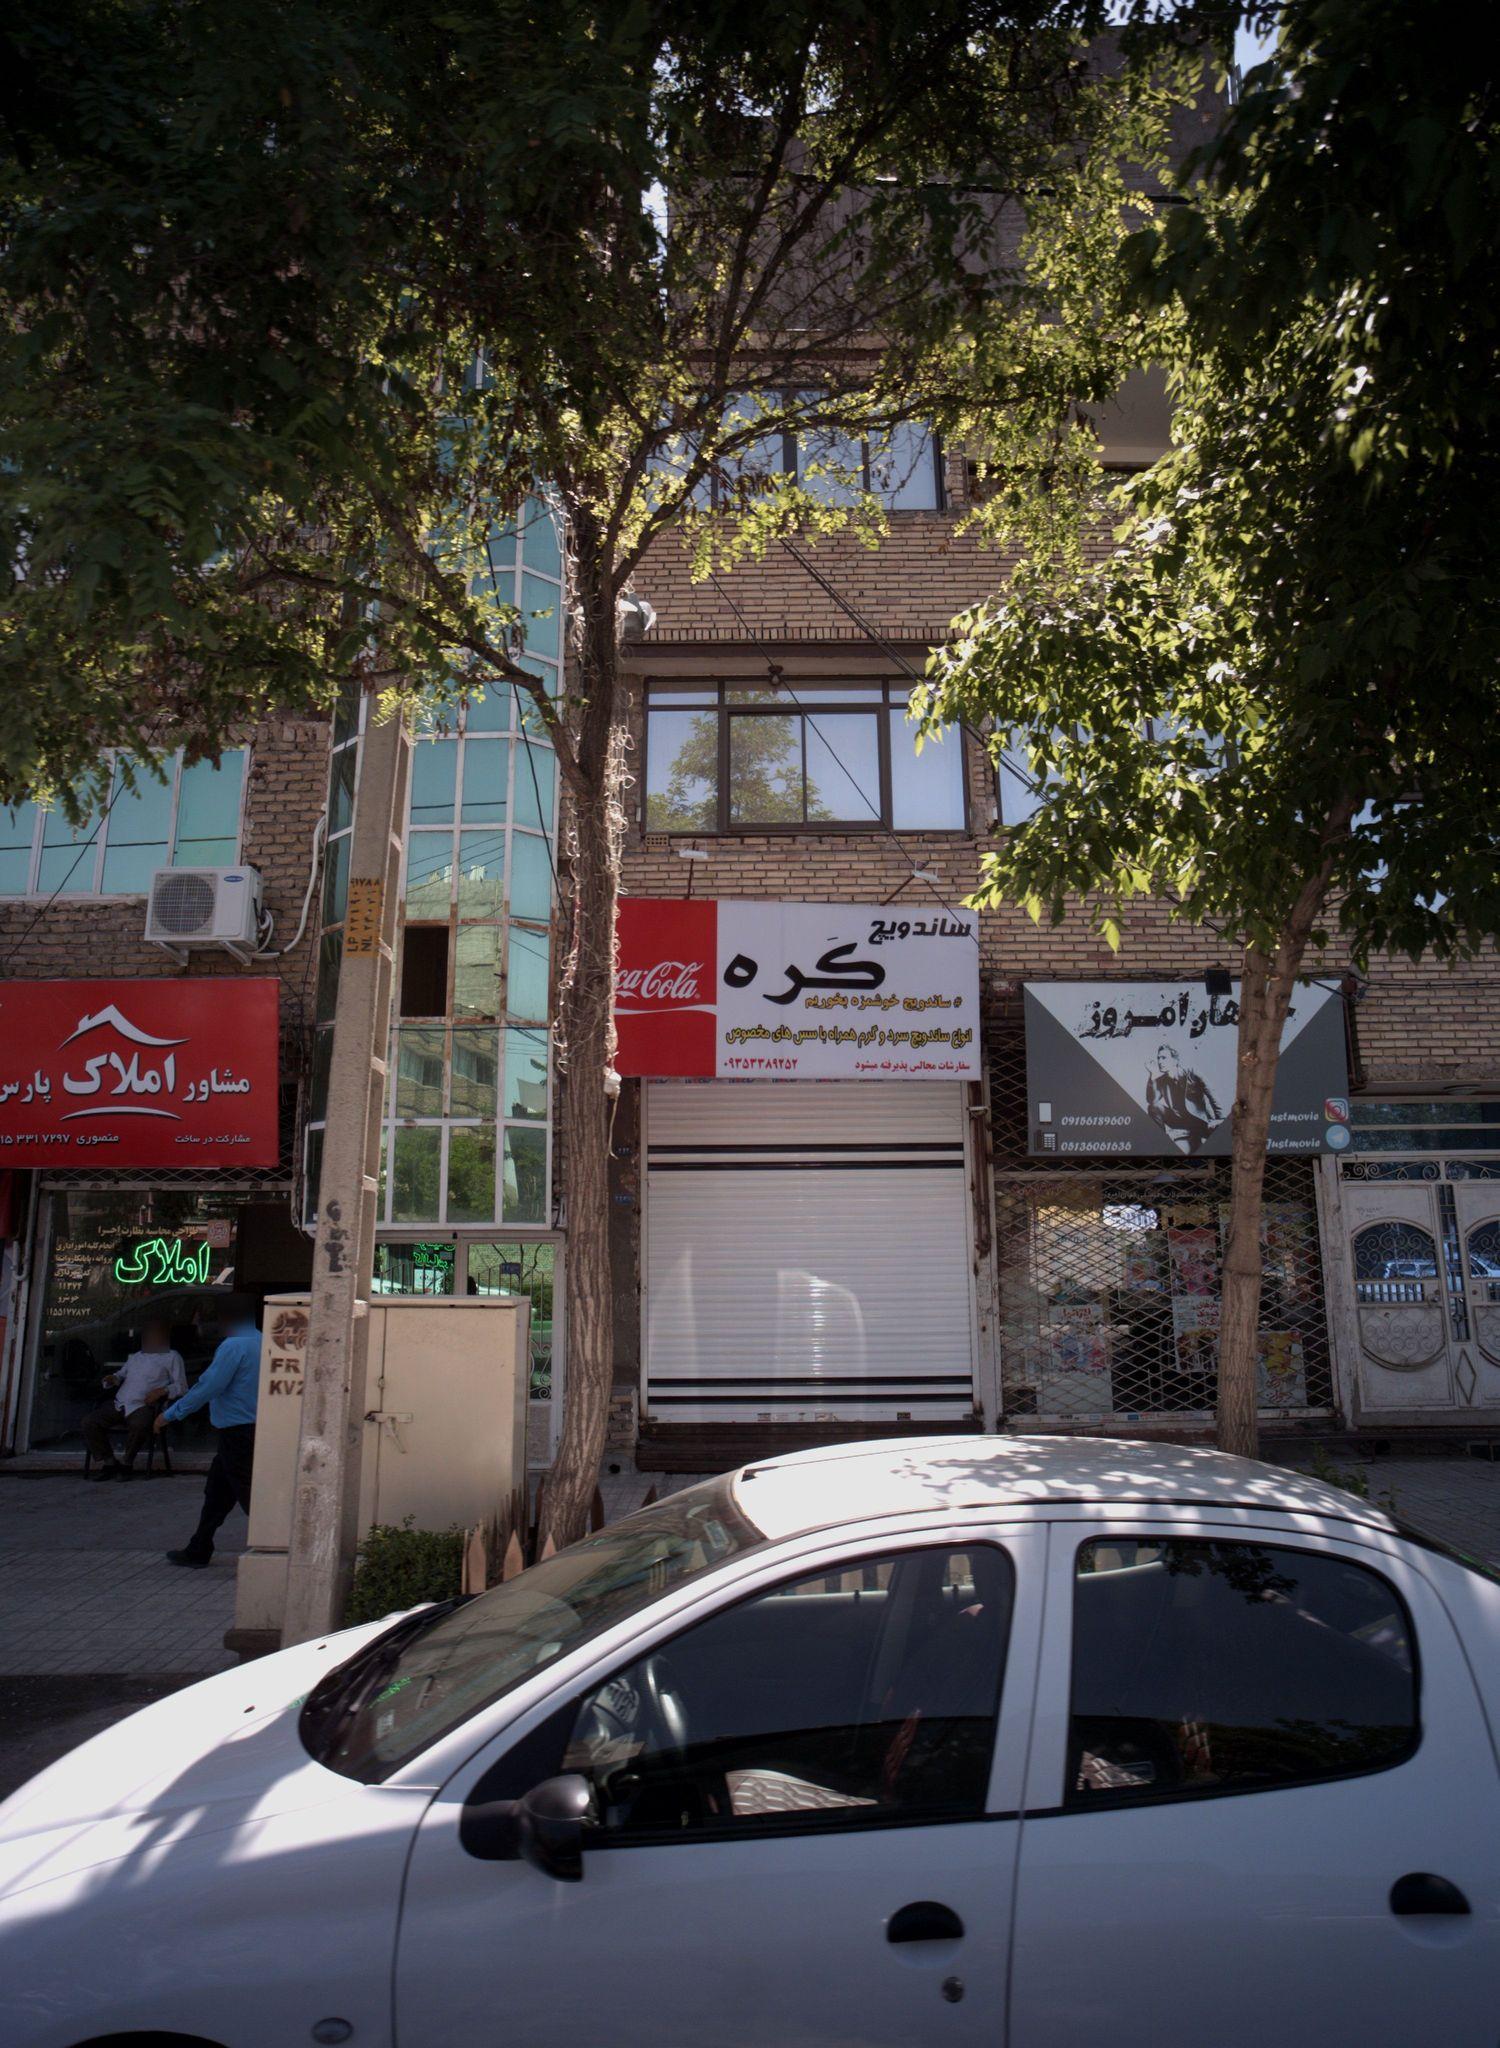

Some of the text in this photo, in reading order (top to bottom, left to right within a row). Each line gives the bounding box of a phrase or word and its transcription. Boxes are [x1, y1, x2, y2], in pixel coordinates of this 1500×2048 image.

[868, 918, 971, 945] ساندویچ
[615, 961, 705, 999] ca-Cola
[805, 993, 848, 1009] بخوریم
[851, 993, 900, 1011] خوشمزه
[903, 994, 952, 1011] ساندویچ
[1080, 990, 1189, 1038] امروز
[726, 1024, 973, 1049] انواع ساندویچ سرد و گرم همراه با سس های مخصوص
[63, 1051, 176, 1095] املاک
[880, 1060, 907, 1072] پذیرفته
[910, 1061, 936, 1072] مجالس
[938, 1061, 970, 1072] سفارشات
[182, 1068, 251, 1102] مشاور
[1270, 1111, 1319, 1122] ustmovie
[76, 1133, 119, 1145] منصوری
[175, 1134, 251, 1145] مشارکت در ساخت
[115, 1237, 211, 1284] املاک
